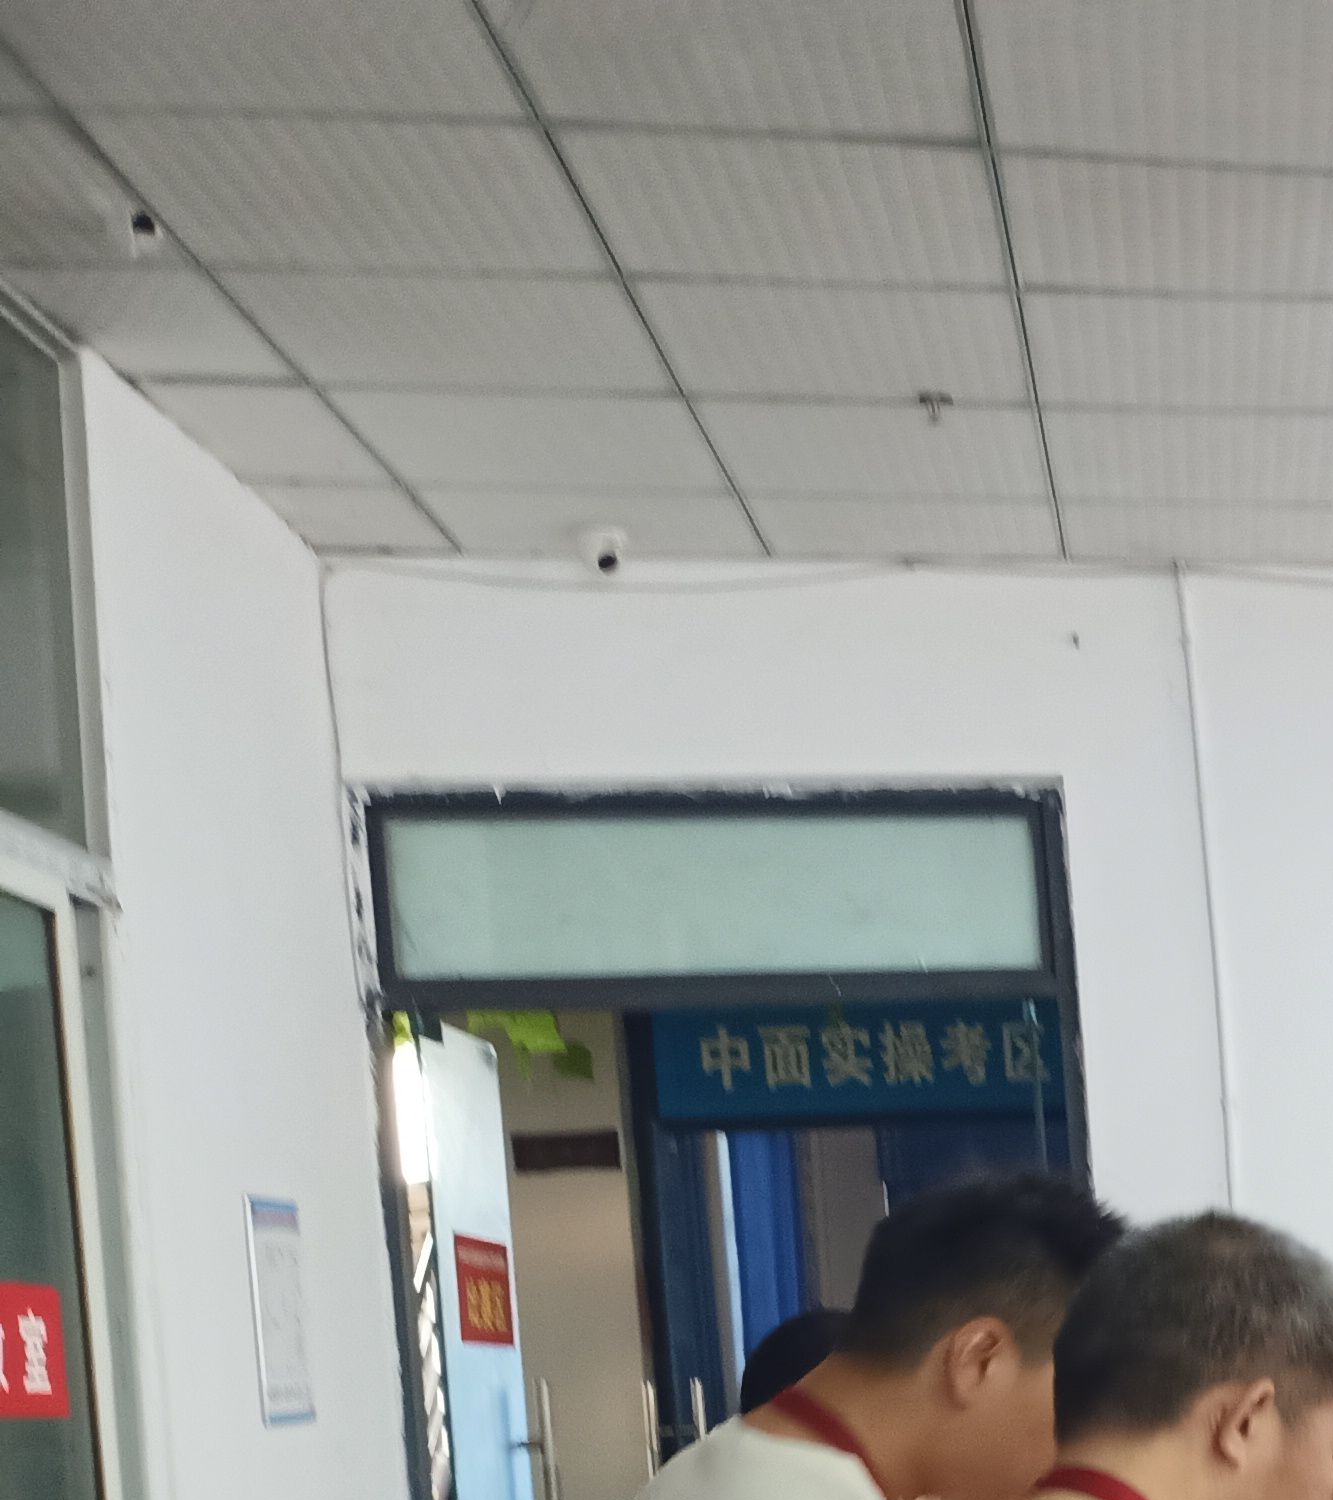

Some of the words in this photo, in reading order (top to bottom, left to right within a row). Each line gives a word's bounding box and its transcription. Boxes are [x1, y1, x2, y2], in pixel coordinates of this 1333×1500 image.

[701, 1019, 1051, 1093] 中面实操考区
